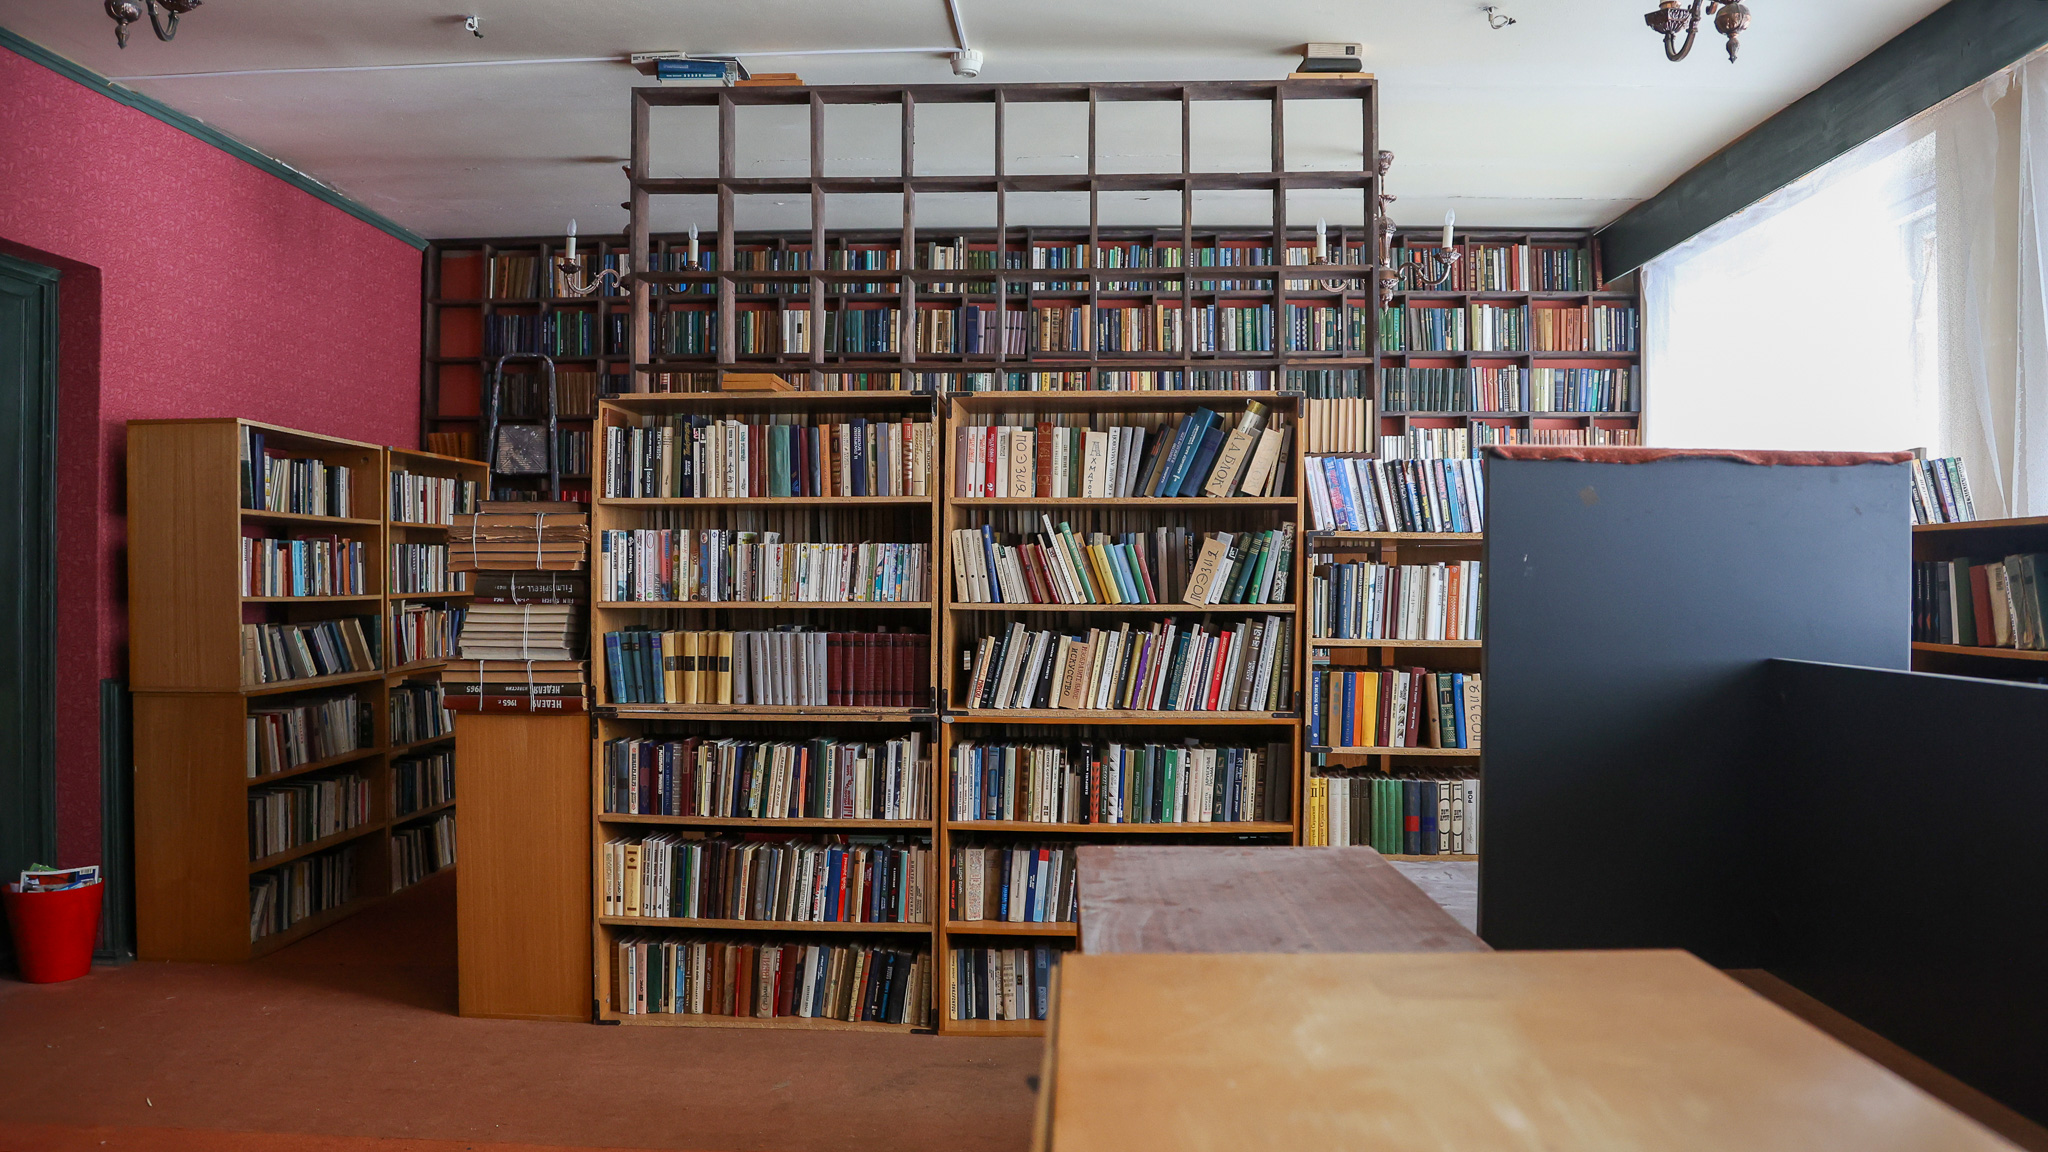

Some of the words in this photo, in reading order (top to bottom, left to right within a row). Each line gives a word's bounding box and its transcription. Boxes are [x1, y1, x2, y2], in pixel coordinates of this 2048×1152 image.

[1015, 435, 1027, 496] ПОЭЗИЯ
[1212, 455, 1236, 488] БЛОК
[1190, 550, 1219, 601] ПОЭЗИЯ
[1064, 647, 1078, 696] ИСКУССТВО
[1469, 685, 1481, 741] ПОЭЗИЯ
[761, 986, 769, 1011] Стефан
